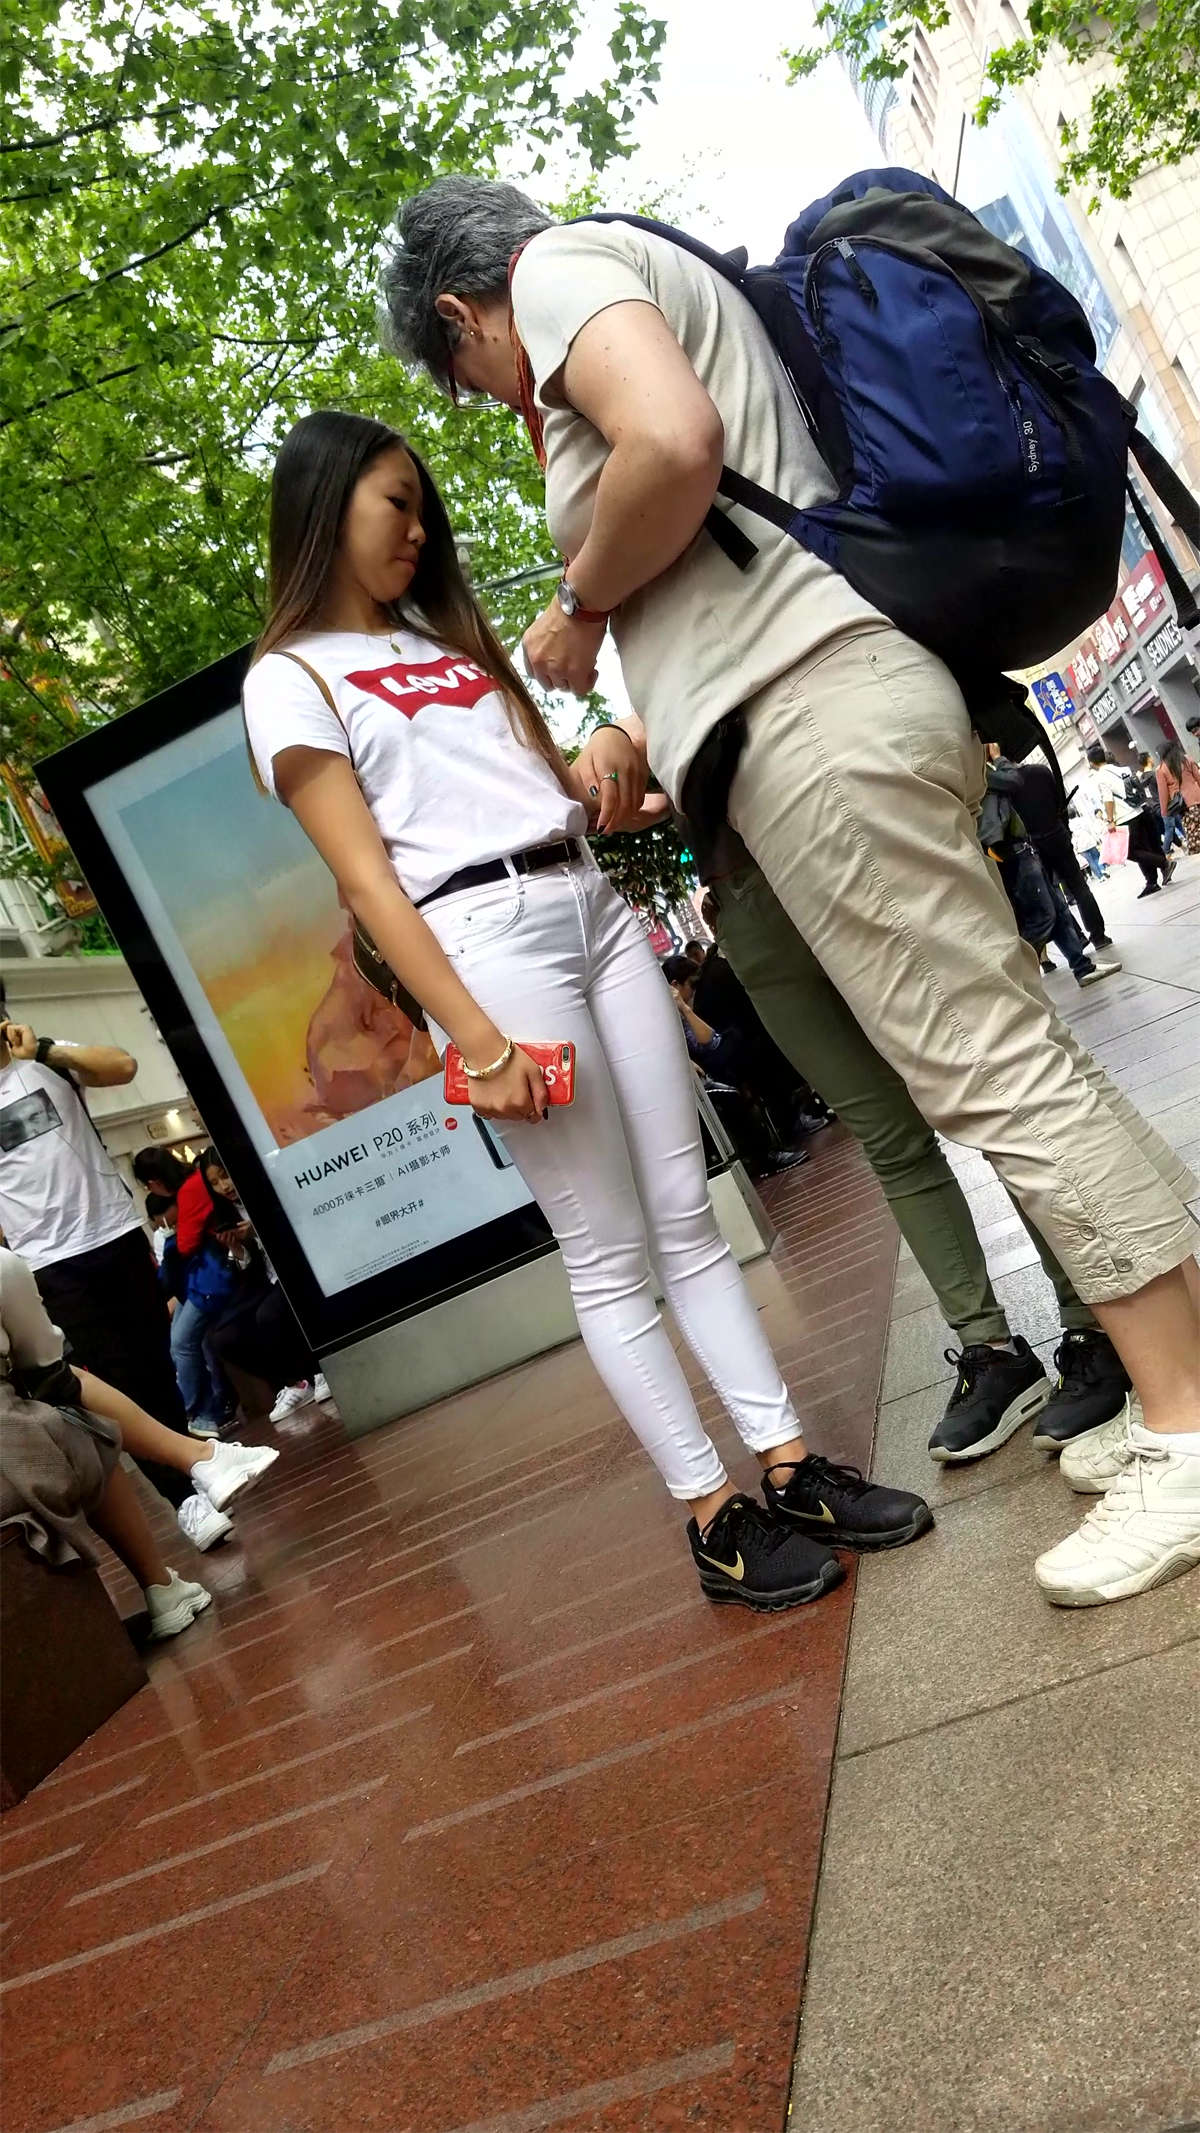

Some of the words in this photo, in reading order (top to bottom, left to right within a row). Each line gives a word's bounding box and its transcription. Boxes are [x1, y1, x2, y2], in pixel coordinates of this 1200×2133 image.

[1023, 420, 1034, 435] 30
[1028, 438, 1040, 473] Sydney
[294, 1143, 369, 1189] HUAWEI
[372, 1127, 404, 1152] P20
[406, 1111, 438, 1137] 系列
